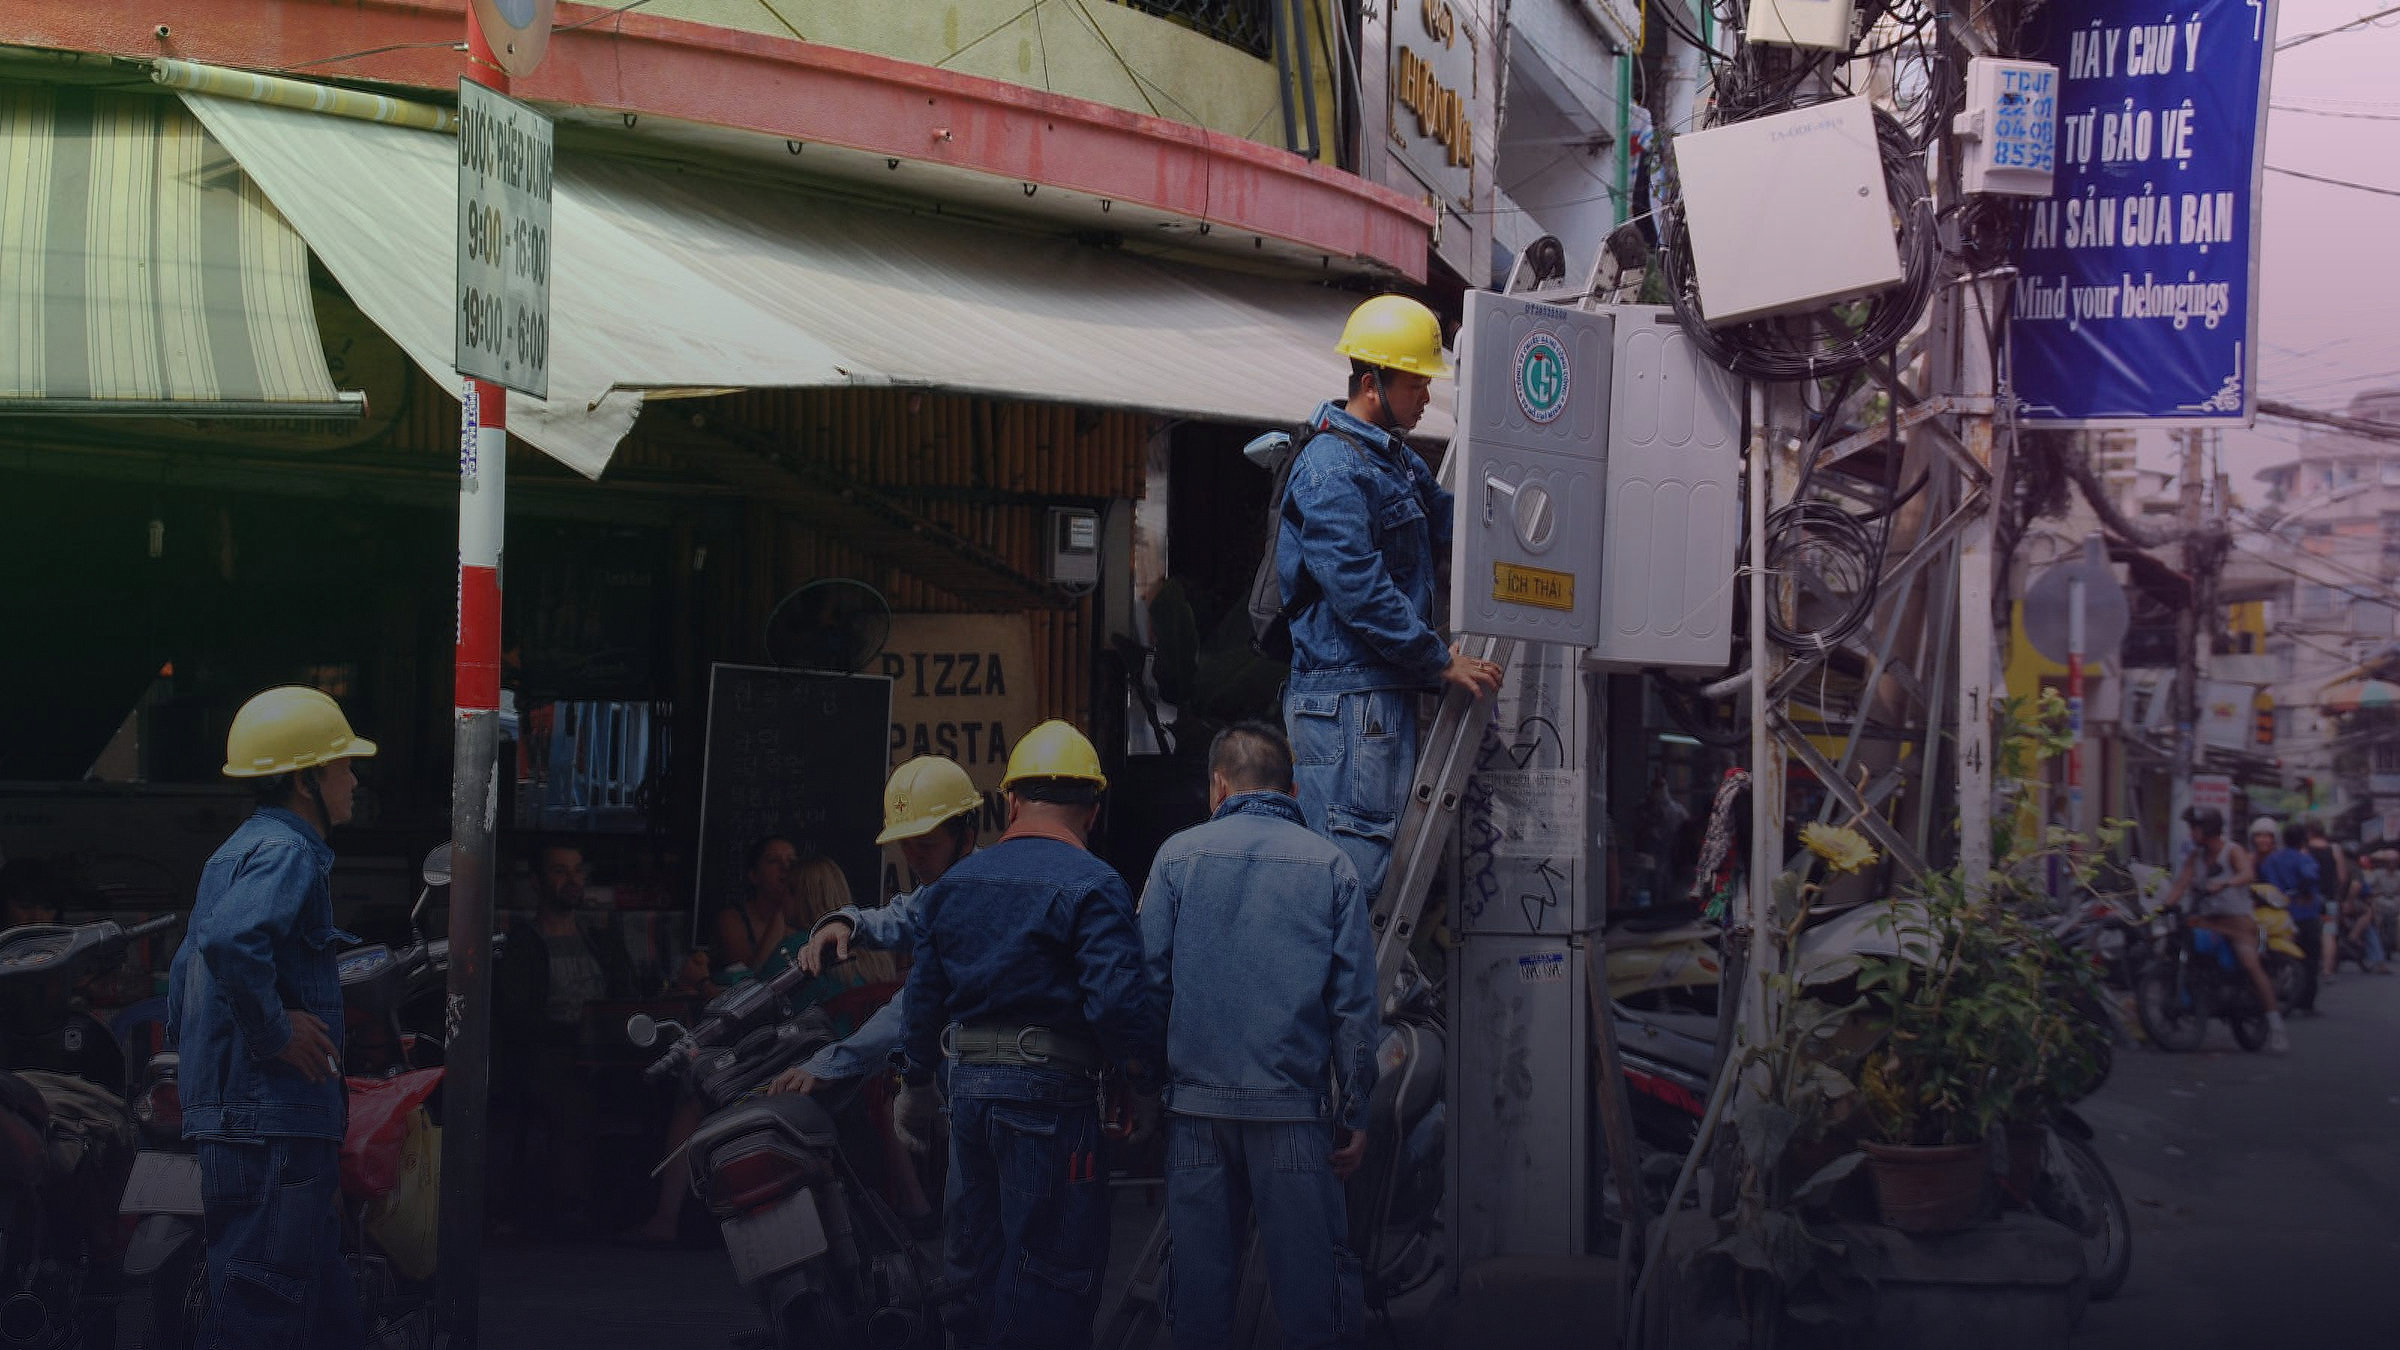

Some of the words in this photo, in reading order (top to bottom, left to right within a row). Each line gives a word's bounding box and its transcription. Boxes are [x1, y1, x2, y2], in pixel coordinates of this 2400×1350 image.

[2068, 17, 2121, 80] HÃY
[2126, 13, 2176, 77] CHÚ
[2185, 10, 2202, 72] Ý
[2064, 106, 2097, 174] TỰ
[2101, 97, 2153, 162] BẢO
[2161, 98, 2195, 171] VỆ
[469, 199, 501, 267] 9:00
[514, 216, 546, 286] 16:00
[2065, 183, 2116, 249] SẢN
[2122, 181, 2173, 247] CỦA
[2180, 191, 2234, 254] BẠN
[463, 285, 502, 354] 19:00
[518, 304, 544, 370] 6:00
[2013, 274, 2067, 320] Mind
[2070, 285, 2120, 332] your
[2122, 269, 2229, 331] belongings
[883, 652, 1005, 697] PIZZA
[890, 720, 1007, 764] PASTA
